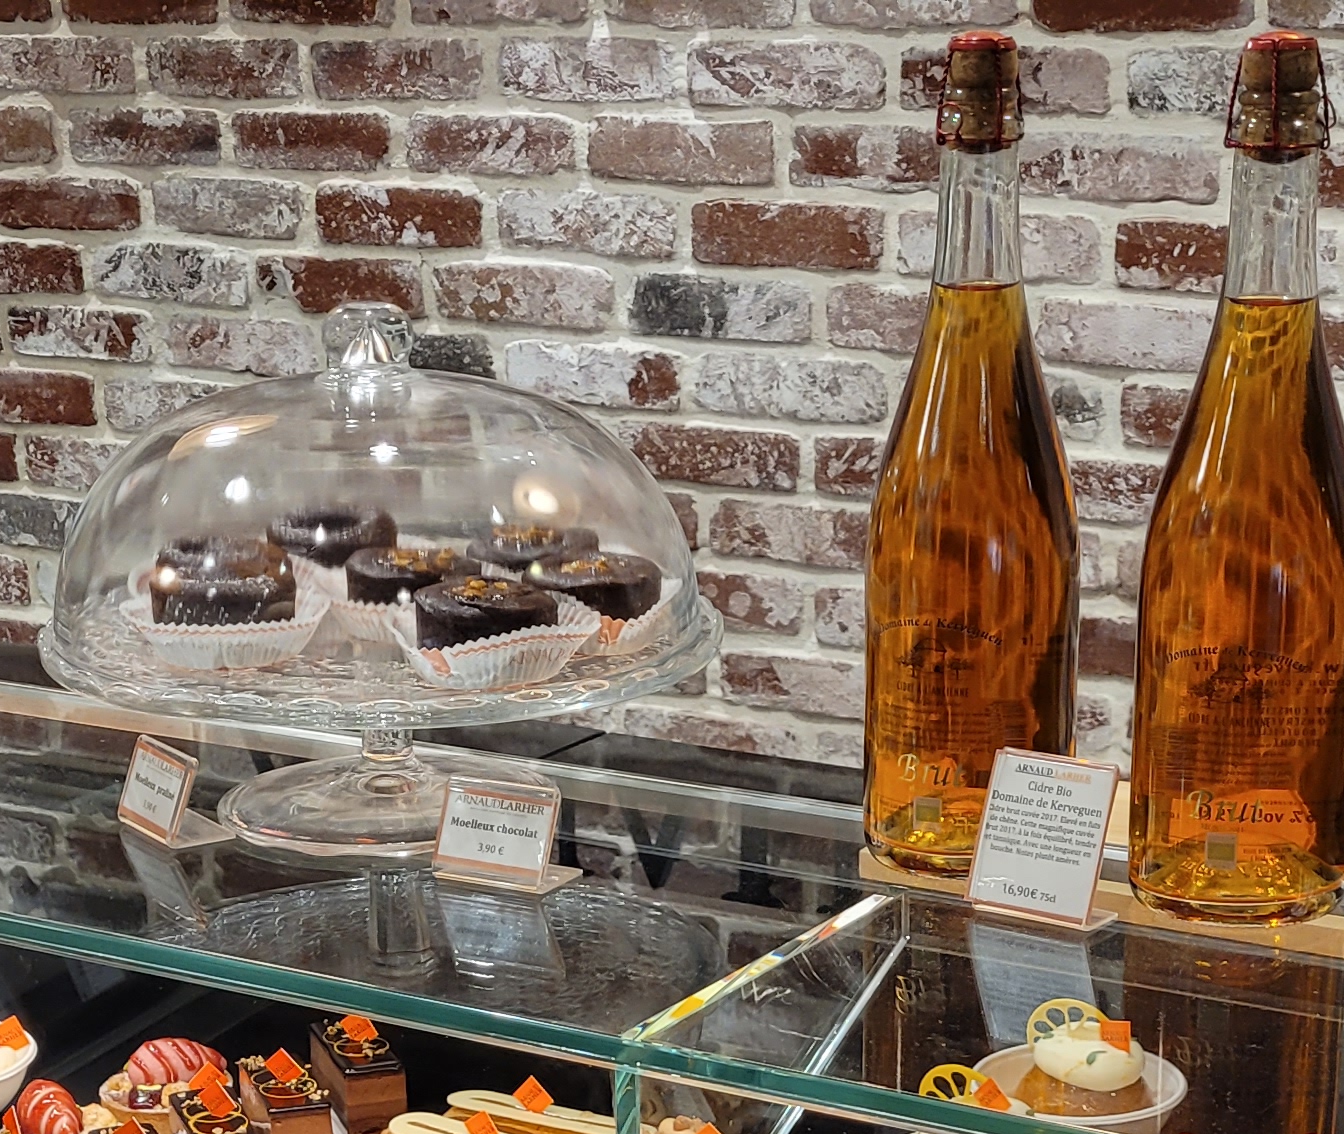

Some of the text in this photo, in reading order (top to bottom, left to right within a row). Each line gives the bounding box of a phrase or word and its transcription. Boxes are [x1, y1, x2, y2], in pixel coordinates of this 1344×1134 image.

[897, 753, 967, 787] Brut
[1016, 763, 1054, 776] ARNAUD
[1028, 781, 1072, 797] Cidre Bio
[456, 794, 545, 815] ARNAUDLARHER
[992, 790, 1102, 818] Domaine de Kerveguen
[451, 816, 538, 839] Moelleux chocolat
[477, 843, 504, 855] 3,90 €
[1002, 883, 1056, 903] 16,90€ 75cl
